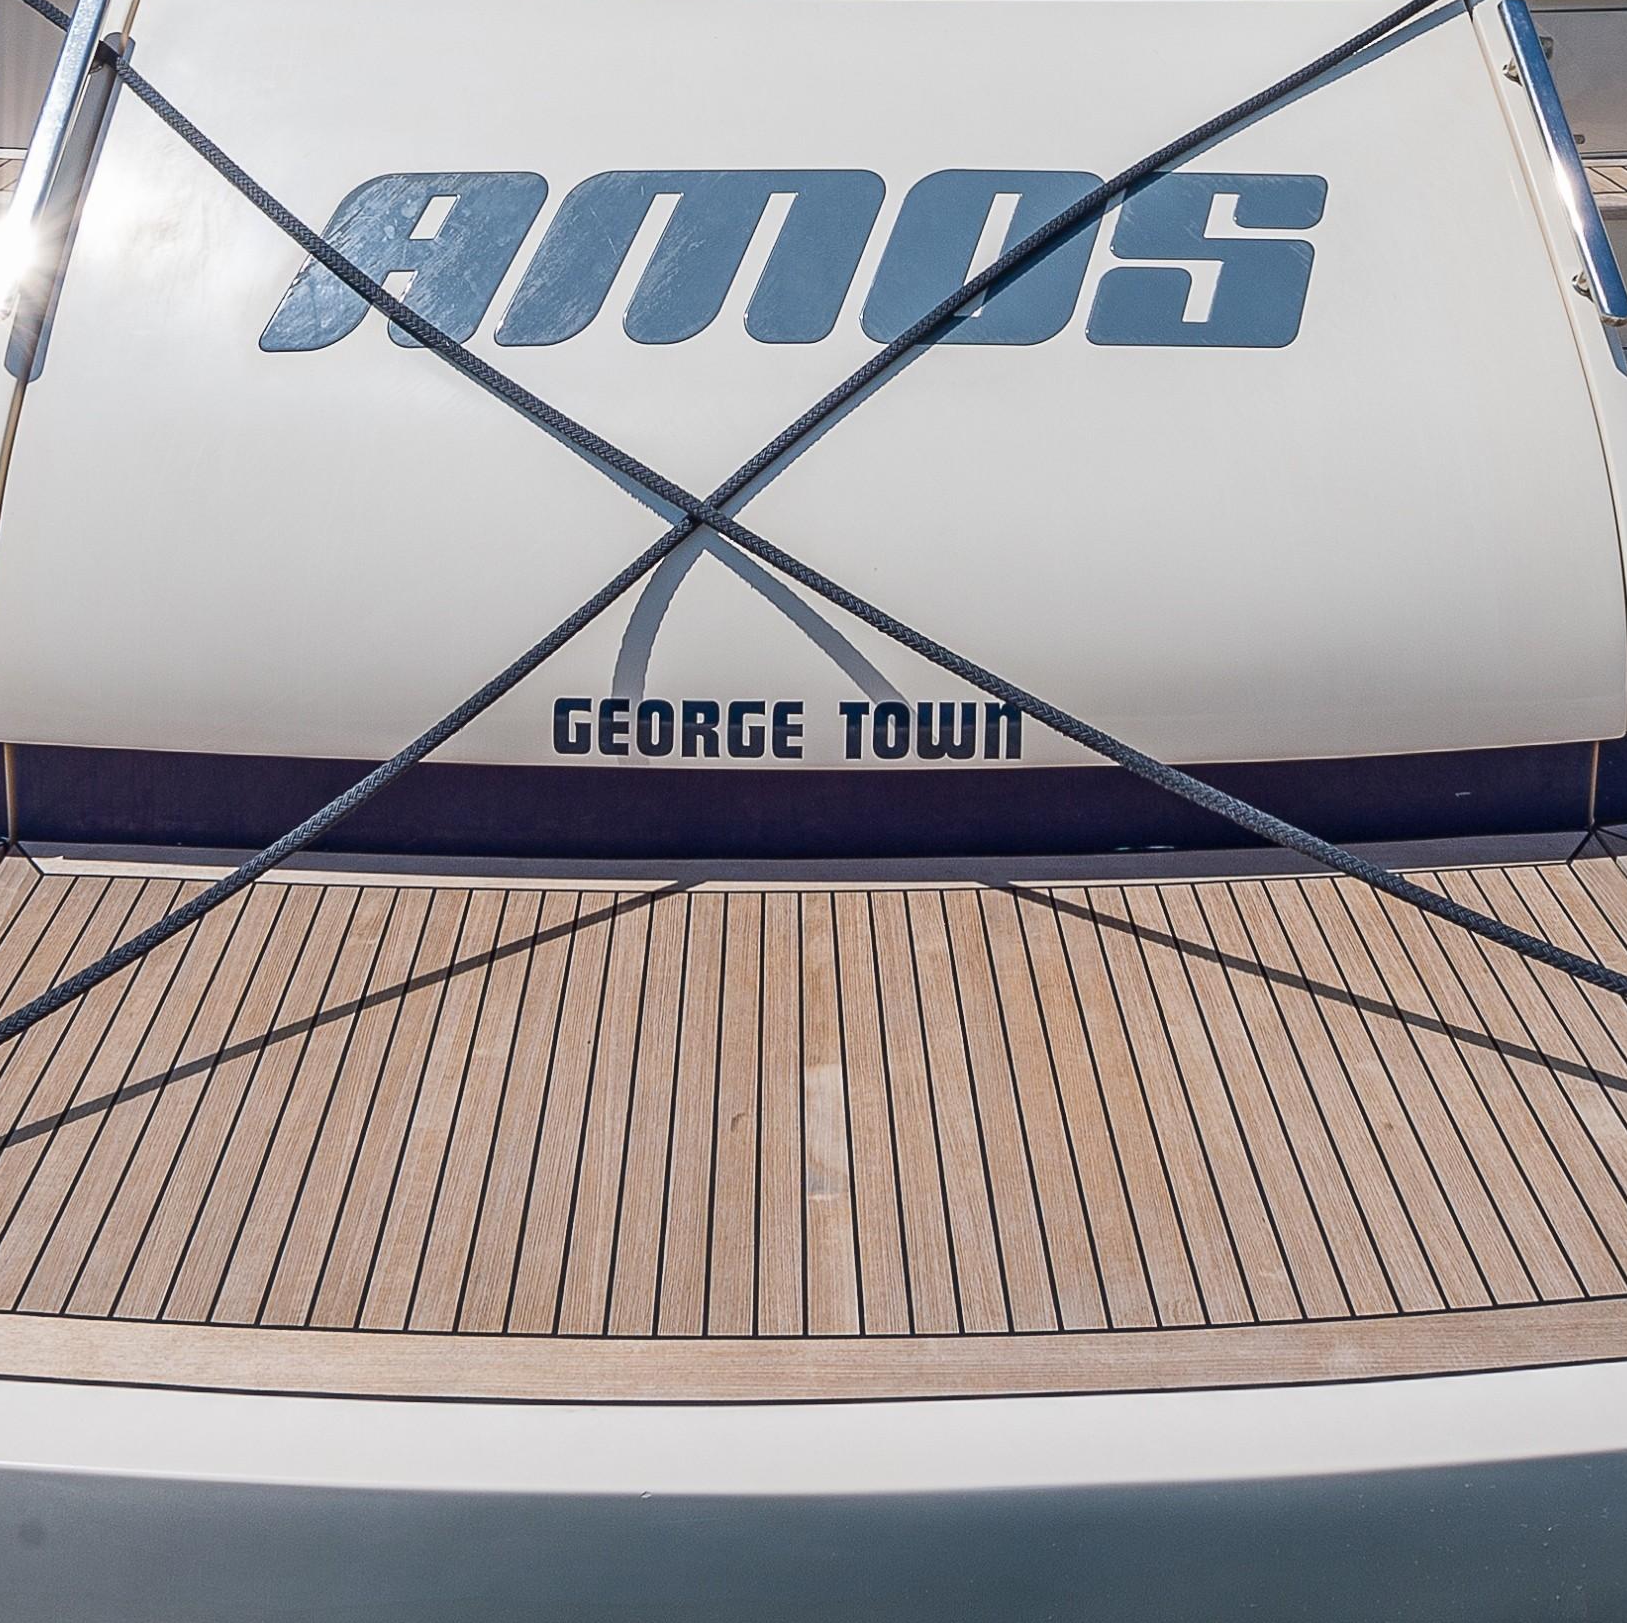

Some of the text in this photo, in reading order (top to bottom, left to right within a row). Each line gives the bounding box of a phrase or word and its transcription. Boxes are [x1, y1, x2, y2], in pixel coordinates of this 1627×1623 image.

[258, 169, 1328, 353] AMOS
[553, 697, 1022, 760] GEORGE TOWN
